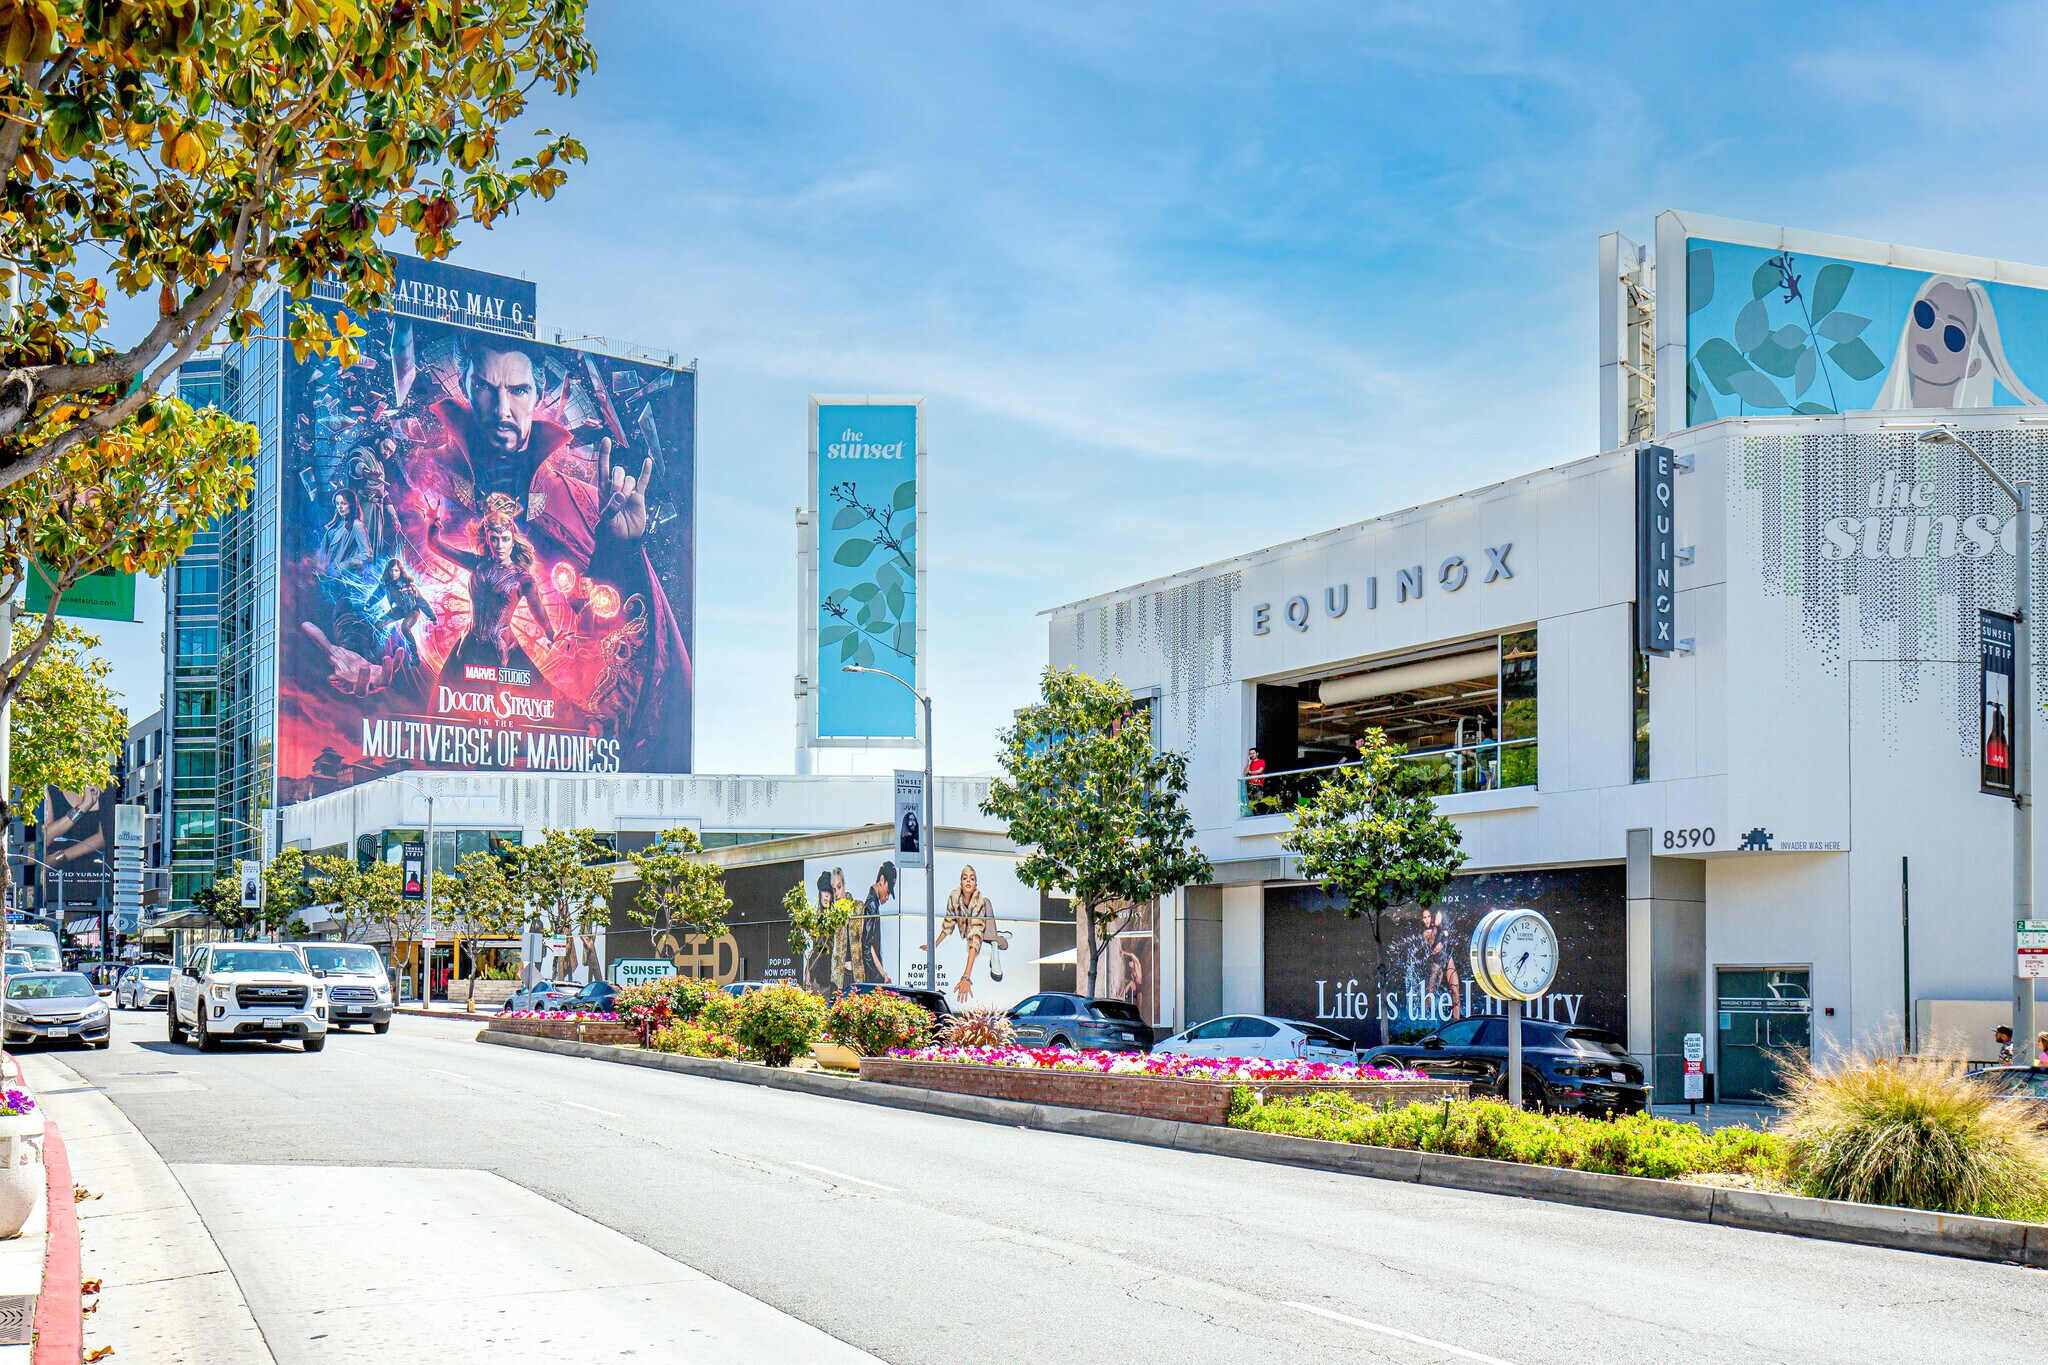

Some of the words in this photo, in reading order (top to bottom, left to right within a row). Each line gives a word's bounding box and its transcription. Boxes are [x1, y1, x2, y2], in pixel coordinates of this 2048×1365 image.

[466, 292, 505, 322] MAY
[512, 302, 523, 325] 6
[841, 428, 864, 442] the
[827, 441, 909, 460] sunset
[1867, 469, 1937, 508] the
[1820, 513, 2048, 560] sunse
[1656, 456, 1672, 641] EQUINOX
[1253, 543, 1514, 636] EQUINOX
[1982, 626, 2012, 642] SUNSET
[1982, 643, 2012, 660] STRIP
[464, 665, 498, 681] MARVEL
[498, 669, 531, 685] STUDIOS
[438, 685, 499, 716] DOCTOR
[497, 690, 555, 721] STRANGE
[478, 718, 489, 726] IN
[494, 719, 514, 728] THE
[362, 718, 493, 768] MULTIVERSE
[498, 731, 521, 768] OF
[527, 732, 621, 774] MADNESS
[1663, 827, 1716, 849] 8590
[1780, 841, 1808, 850] INVADER
[1809, 841, 1823, 850] WAS
[1824, 841, 1841, 850] HERE
[1511, 926, 1518, 934] 11
[2018, 921, 2024, 929] 2
[1504, 934, 1511, 944] 10
[622, 965, 670, 975] SUNSET
[769, 958, 781, 966] POP
[782, 958, 791, 966] UP
[764, 969, 778, 977] NOW
[779, 968, 796, 976] OPEN
[1316, 979, 1369, 1020] Life
[1376, 982, 1399, 1020] is
[1405, 980, 1453, 1021] the
